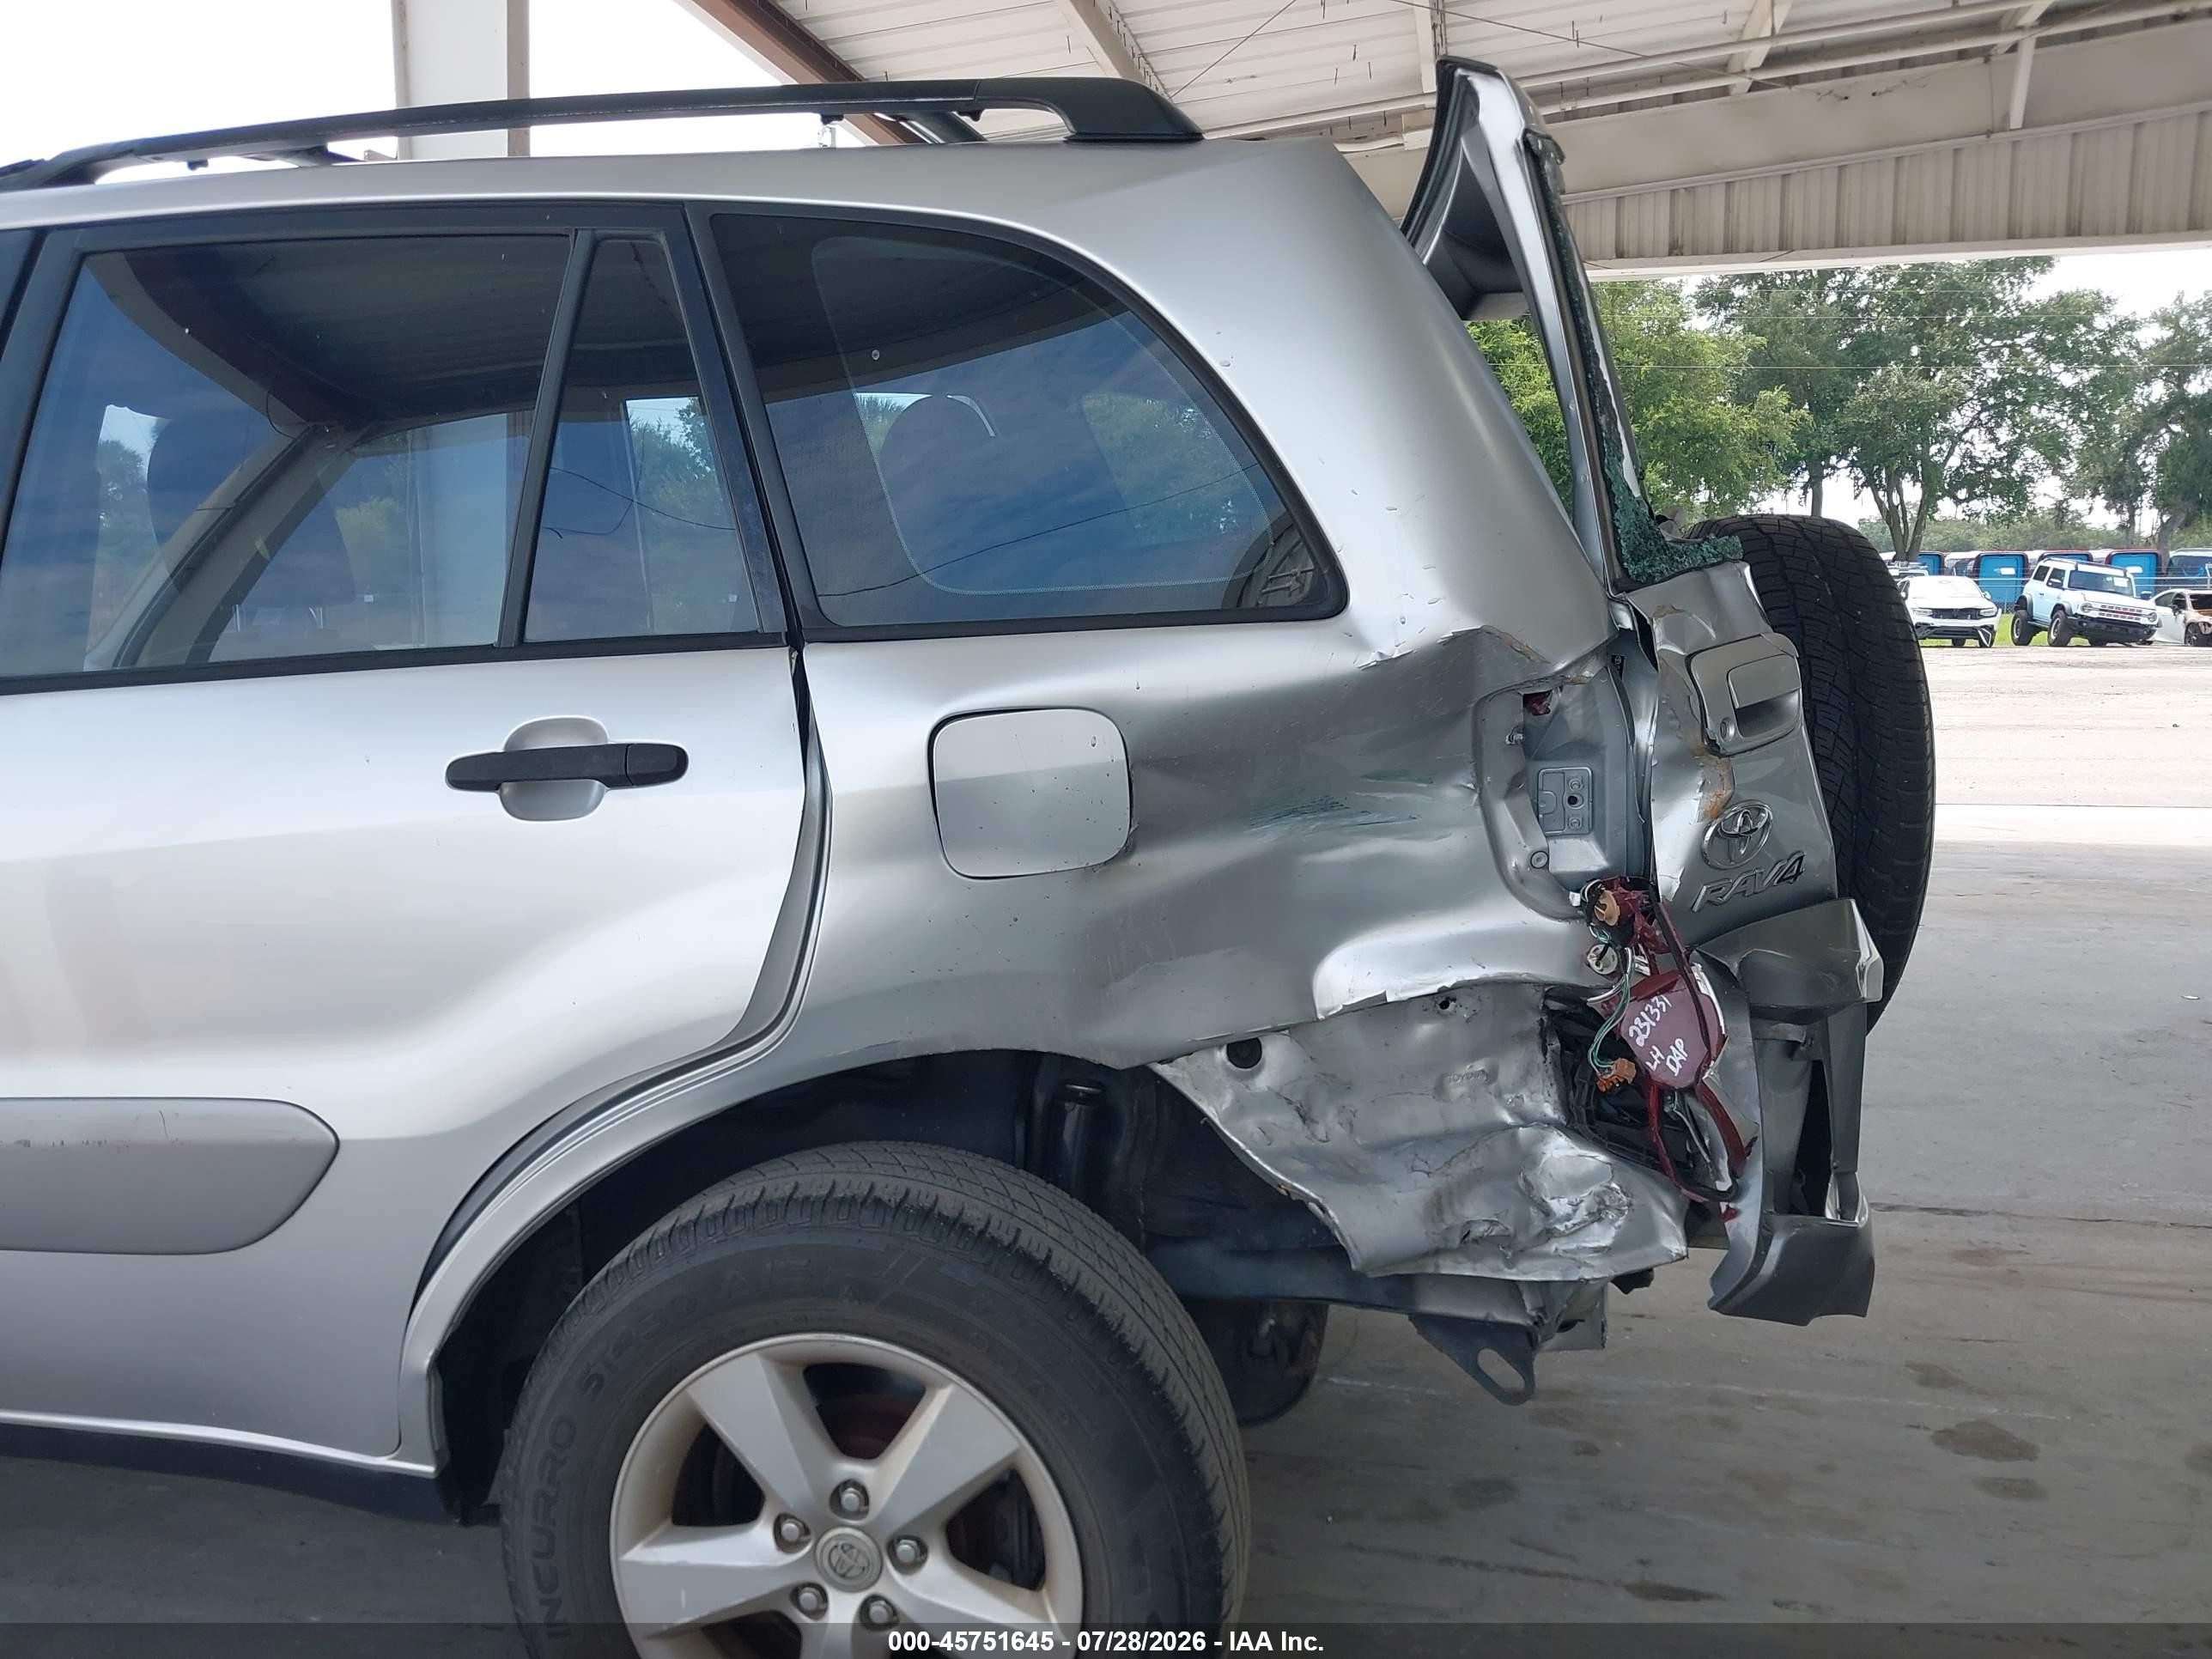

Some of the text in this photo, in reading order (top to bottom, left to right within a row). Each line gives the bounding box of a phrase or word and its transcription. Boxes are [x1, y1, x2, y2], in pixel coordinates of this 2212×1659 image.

[1691, 850, 1806, 912] RAV4
[1628, 994, 1672, 1047] 231331
[1645, 1045, 1665, 1072] LH
[1666, 1038, 1688, 1076] DAP
